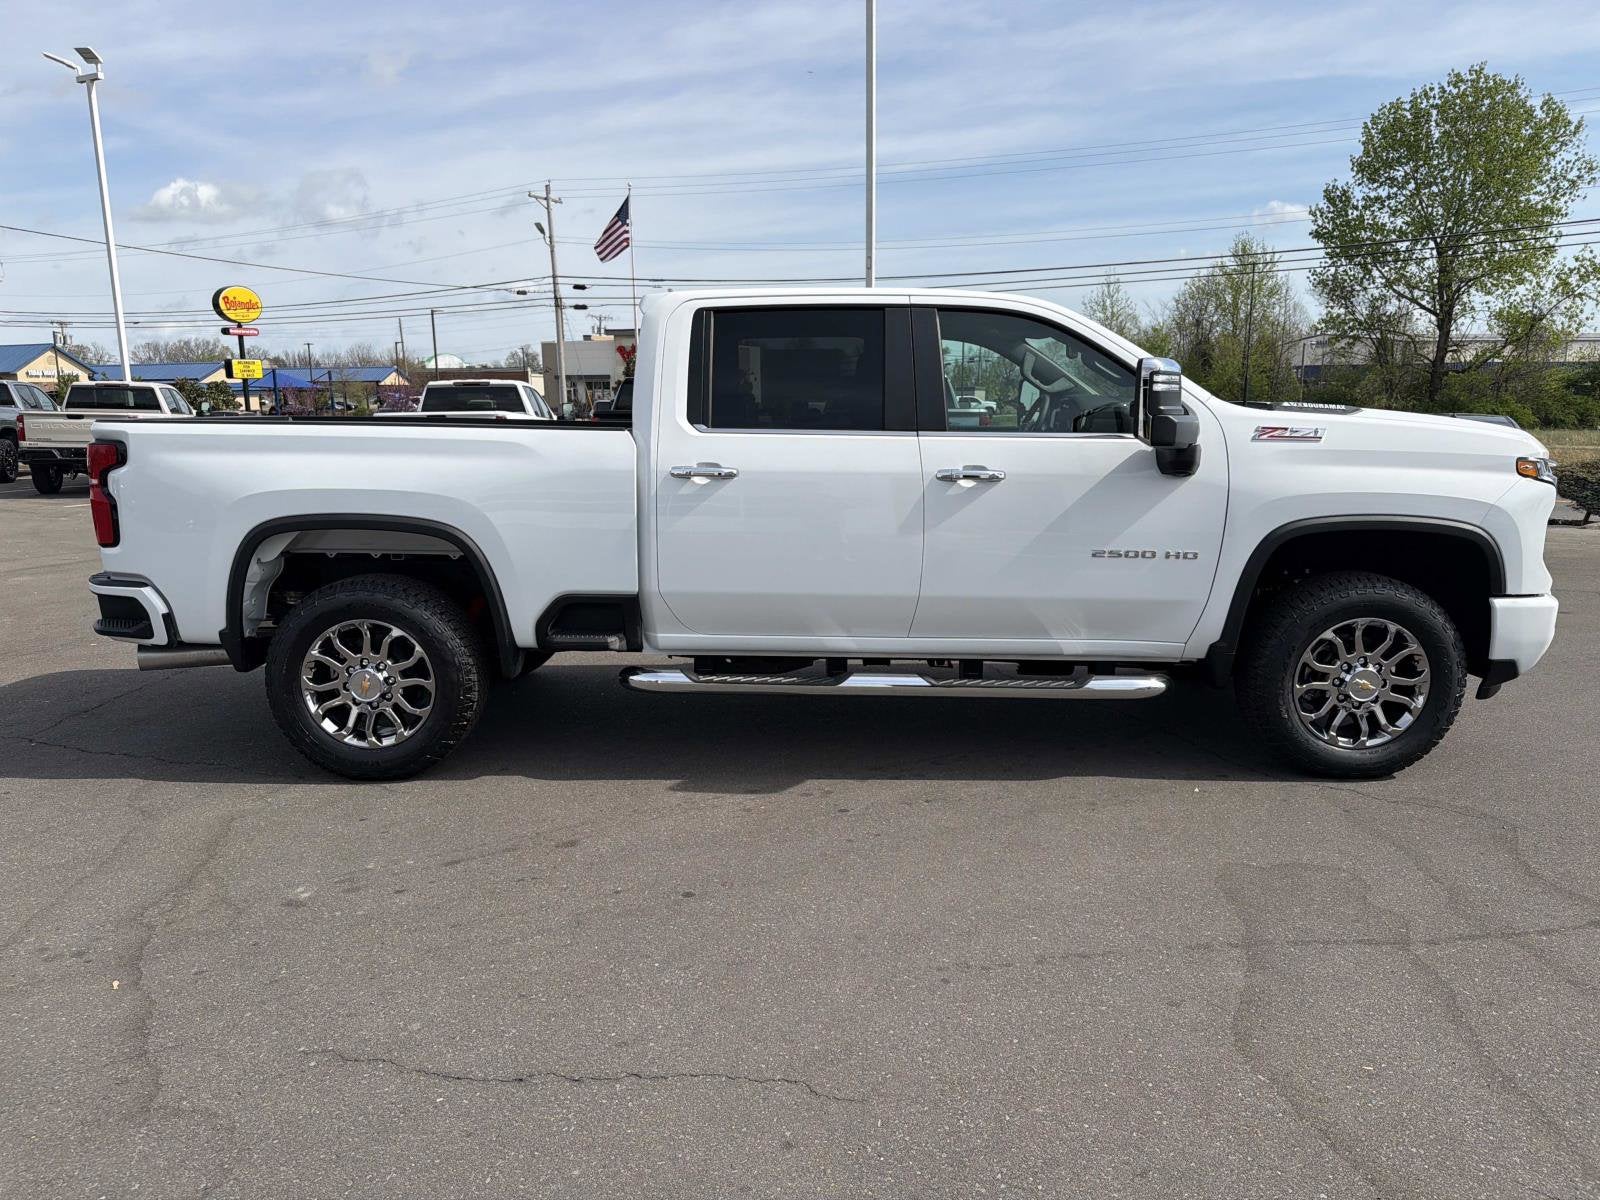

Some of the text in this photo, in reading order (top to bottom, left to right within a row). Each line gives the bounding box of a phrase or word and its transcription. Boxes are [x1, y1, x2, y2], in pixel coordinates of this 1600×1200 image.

[222, 296, 259, 311] Bojangles
[1308, 402, 1346, 410] DURAMAX
[1251, 425, 1326, 442] Z71
[1091, 549, 1199, 560] 2500 HD
